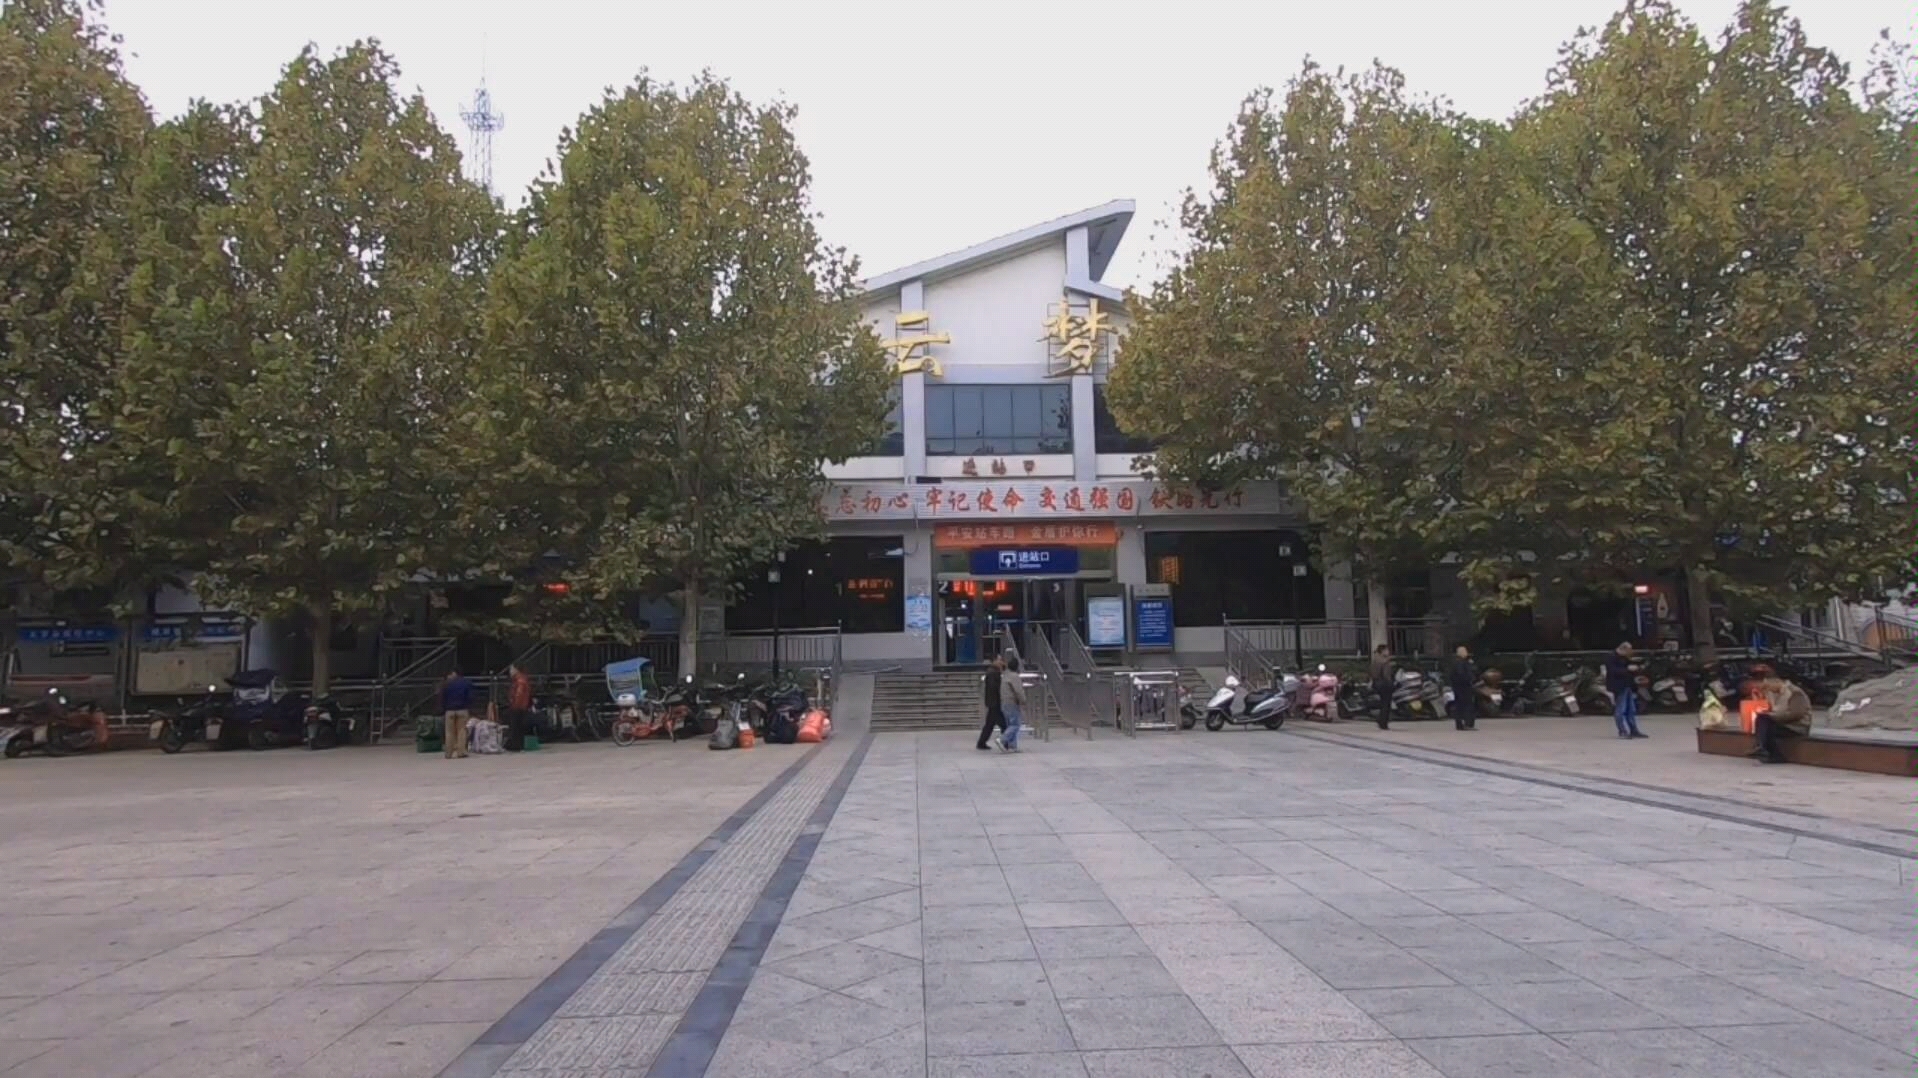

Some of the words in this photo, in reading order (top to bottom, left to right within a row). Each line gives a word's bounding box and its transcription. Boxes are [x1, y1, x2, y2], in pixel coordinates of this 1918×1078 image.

[926, 486, 1025, 517] 牢记使命
[1039, 486, 1134, 512] 交通强国
[1018, 551, 1050, 563] 进站口
[937, 581, 949, 594] 2
